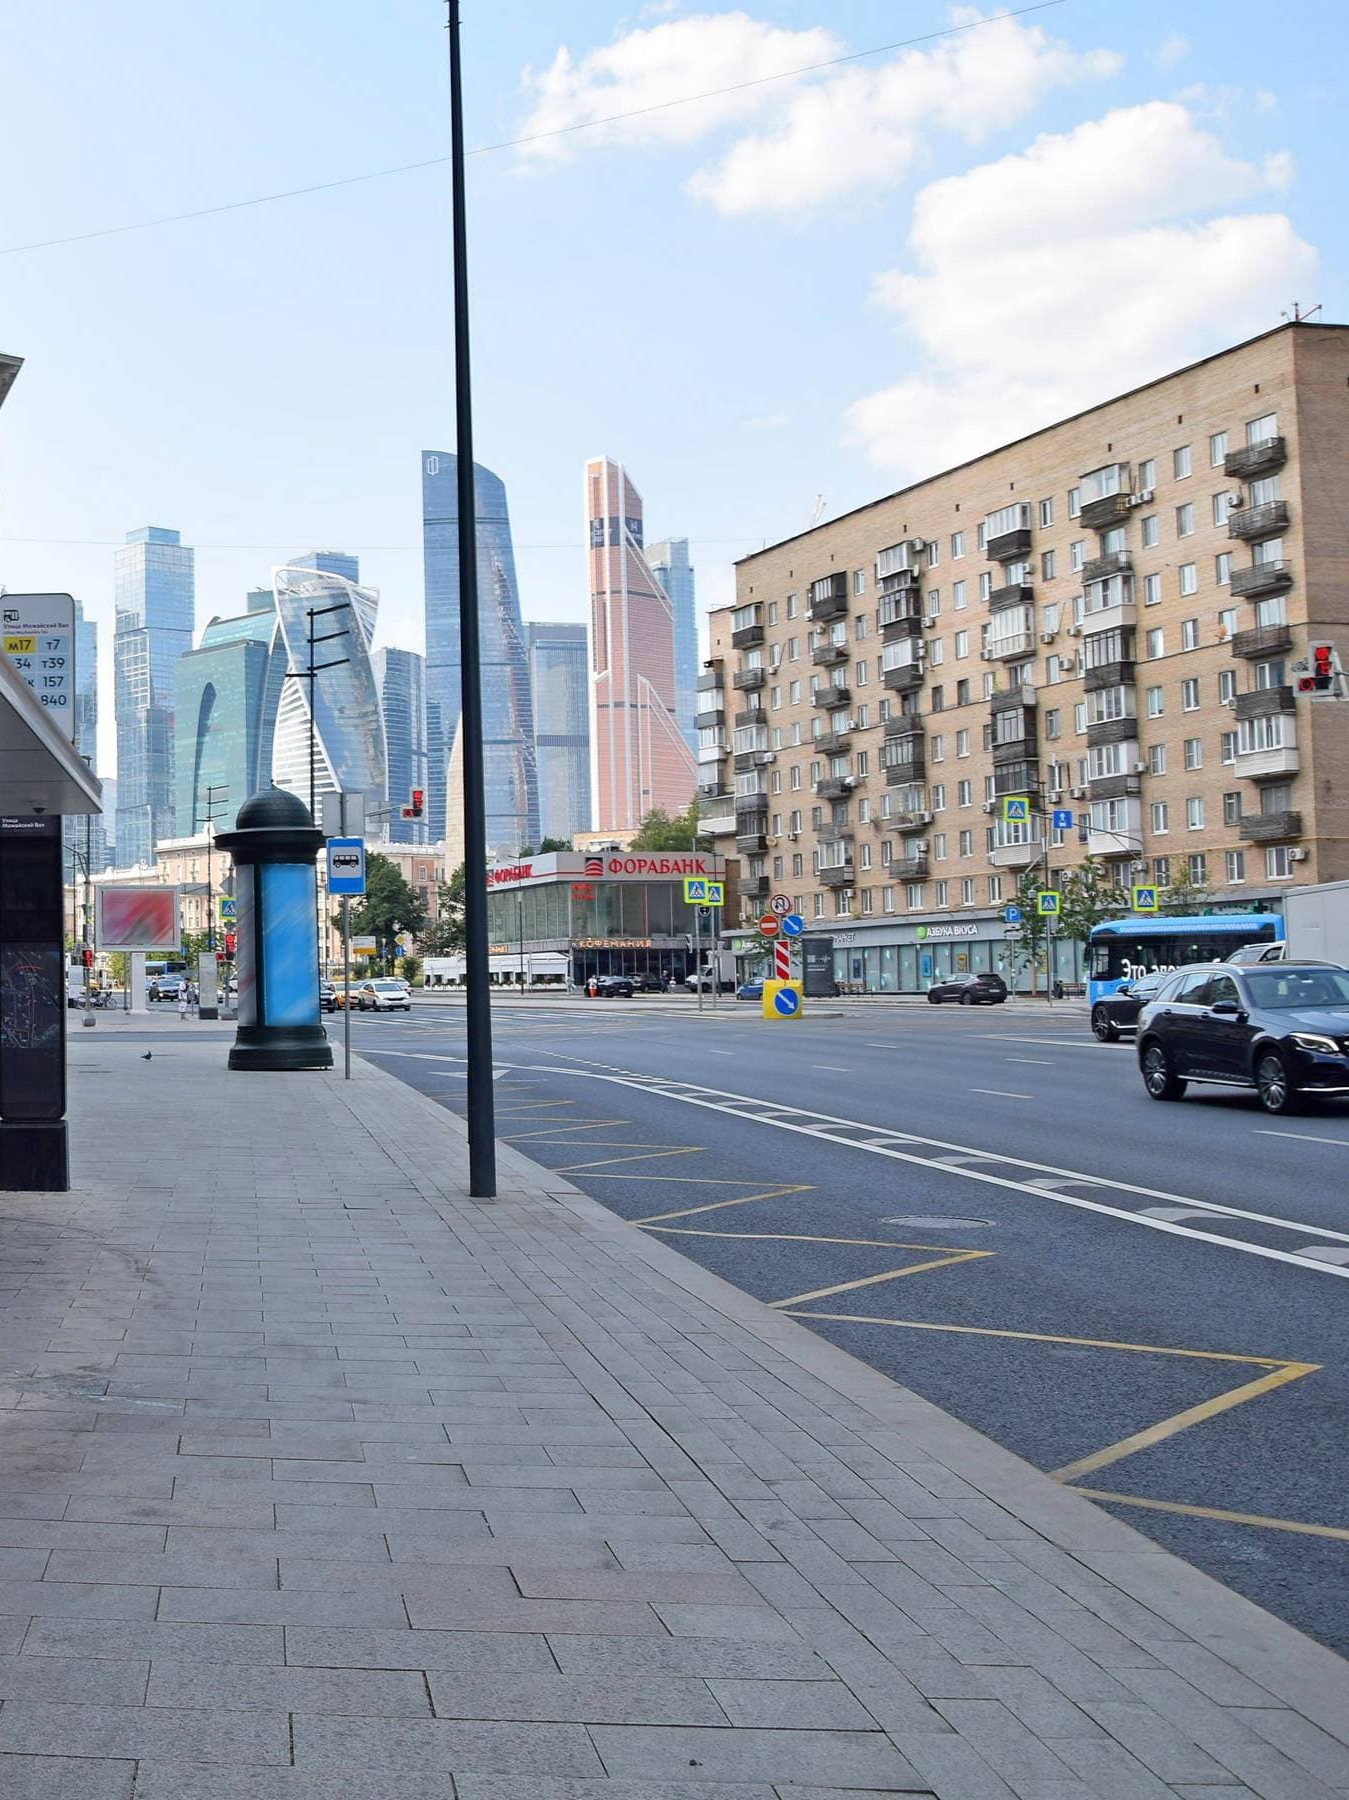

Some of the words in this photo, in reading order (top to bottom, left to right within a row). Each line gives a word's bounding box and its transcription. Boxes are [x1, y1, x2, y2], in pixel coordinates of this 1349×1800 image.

[8, 639, 32, 651] м17
[45, 639, 61, 650] т7
[41, 657, 66, 669] т39
[42, 676, 65, 688] 157
[40, 694, 67, 706] 840
[608, 858, 707, 875] ФОРАБАНК
[926, 926, 954, 937] АЗБУКА
[954, 924, 978, 936] ВКУСА
[579, 940, 652, 949] КОФЕМАНИЯ
